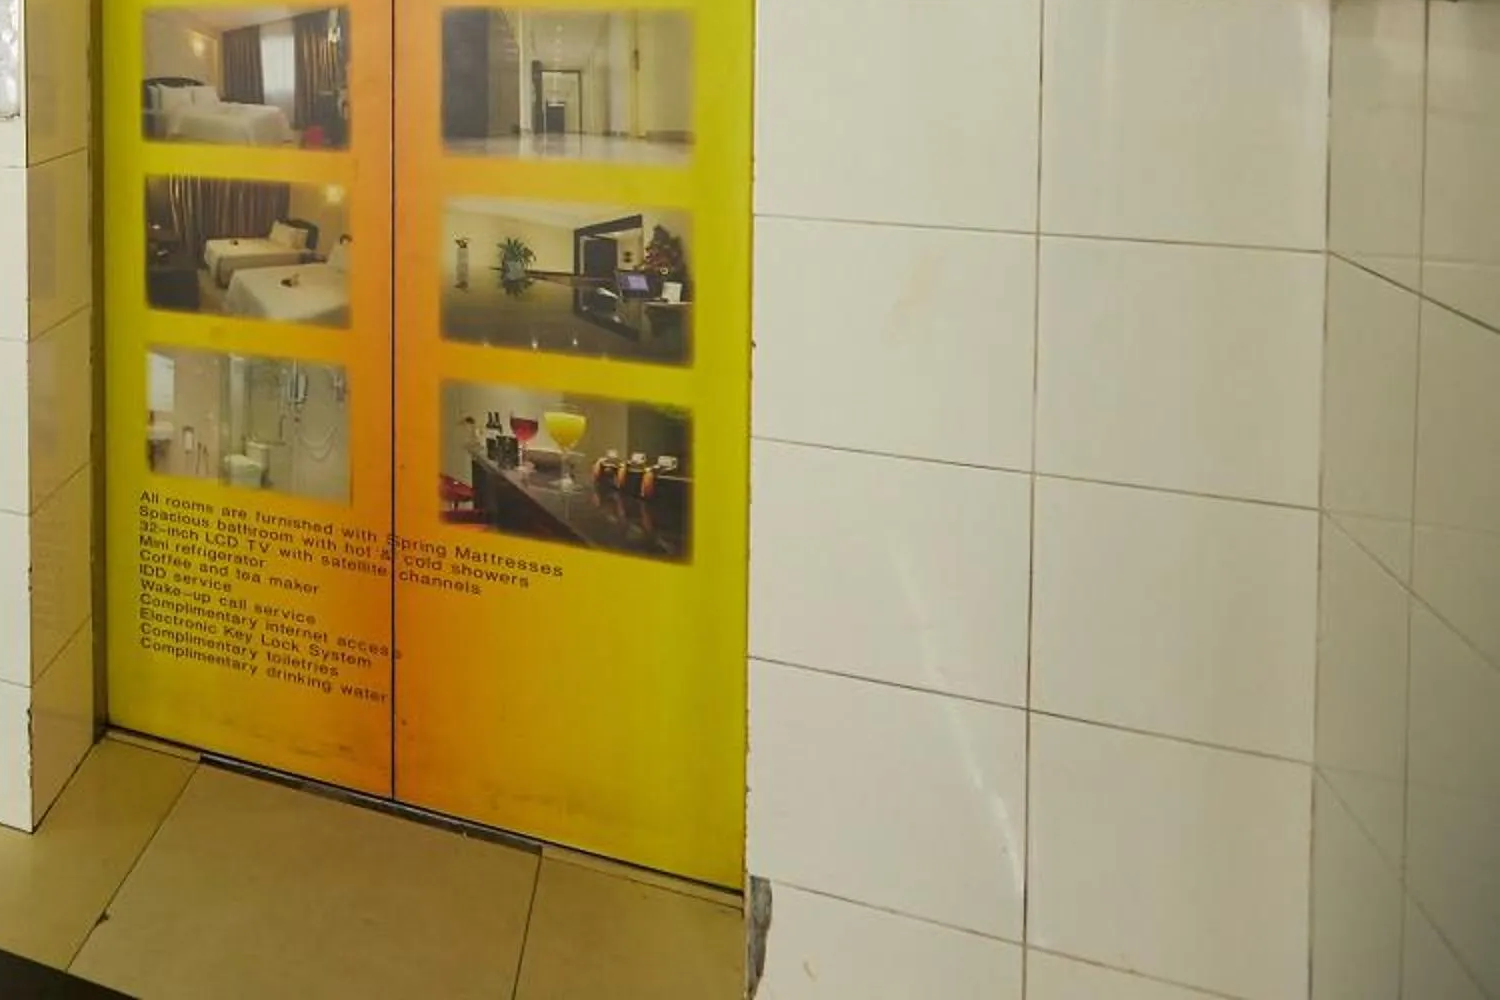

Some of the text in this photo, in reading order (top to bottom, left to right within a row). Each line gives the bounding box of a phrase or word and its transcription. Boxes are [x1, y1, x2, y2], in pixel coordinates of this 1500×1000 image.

[139, 505, 209, 528] Spacious
[217, 520, 293, 543] bathroom
[303, 537, 337, 552] with
[344, 543, 371, 559] hot
[404, 556, 443, 571] cold
[452, 564, 529, 588] showers
[139, 535, 267, 568] Mini refrigerator
[139, 520, 482, 595] 32-inch LCD TV with satellite channels
[140, 490, 564, 577] All rooms are furnished with Spring Mattresses
[139, 549, 320, 595] Coffee and tea maker
[139, 563, 232, 593] IDD service
[139, 593, 257, 630] Complimentary
[336, 637, 403, 660] access
[141, 580, 317, 626] Wake-up call service
[139, 607, 372, 668] Electronic Key Lock System
[140, 622, 339, 677] Complimentary toiletries
[140, 637, 389, 703] Complimentary drinking water
